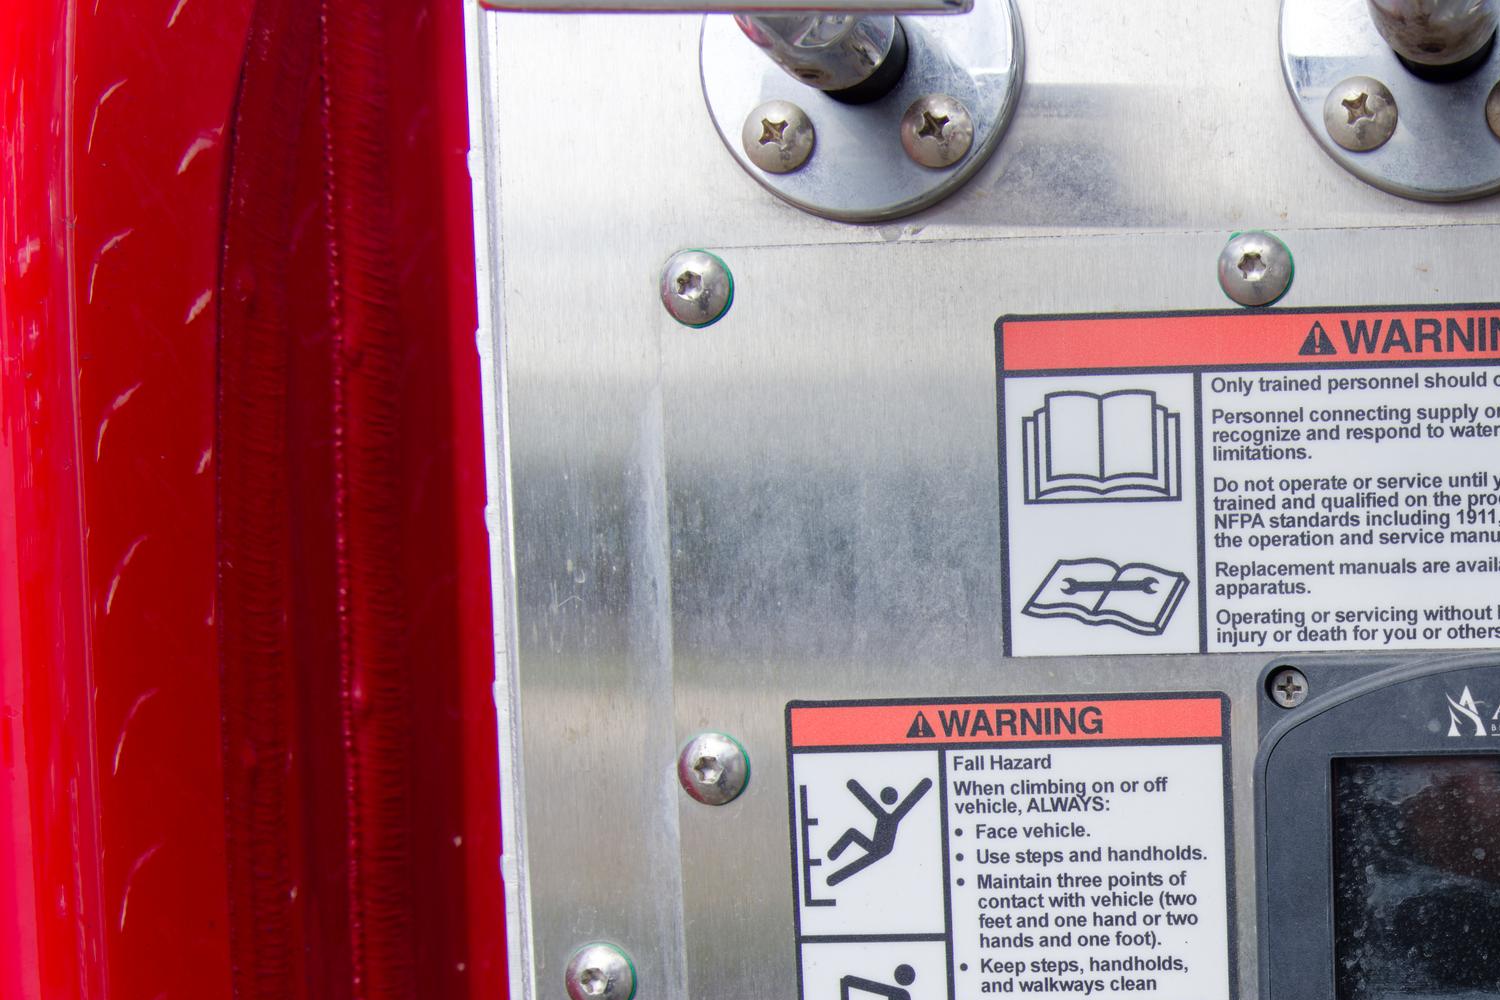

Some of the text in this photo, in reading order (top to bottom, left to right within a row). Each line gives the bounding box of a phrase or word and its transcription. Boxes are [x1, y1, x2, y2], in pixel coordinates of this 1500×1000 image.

[1211, 377, 1253, 396] Only
[1258, 375, 1321, 392] trained
[1328, 373, 1418, 394] personnel
[1424, 372, 1486, 388] should
[1212, 406, 1303, 423] Personnel
[1309, 405, 1410, 424] connecting
[1416, 403, 1479, 423] supply
[1214, 513, 1265, 529] NFPA
[1269, 511, 1360, 528] standards
[1366, 510, 1450, 529] including
[1216, 627, 1267, 646] injury
[1272, 630, 1292, 642] or
[1296, 626, 1347, 642] death
[1352, 625, 1378, 641] for
[1382, 628, 1416, 644] you
[1422, 628, 1442, 640] or
[939, 706, 1103, 737] WARNING
[953, 754, 1051, 771] Fall Hazard
[952, 776, 1168, 797] When climbing on or off
[954, 796, 1109, 815] vehicle, ALWAYS:
[976, 845, 1207, 866] Use steps and handholds.
[980, 955, 1188, 976] Keep steps, handholds,
